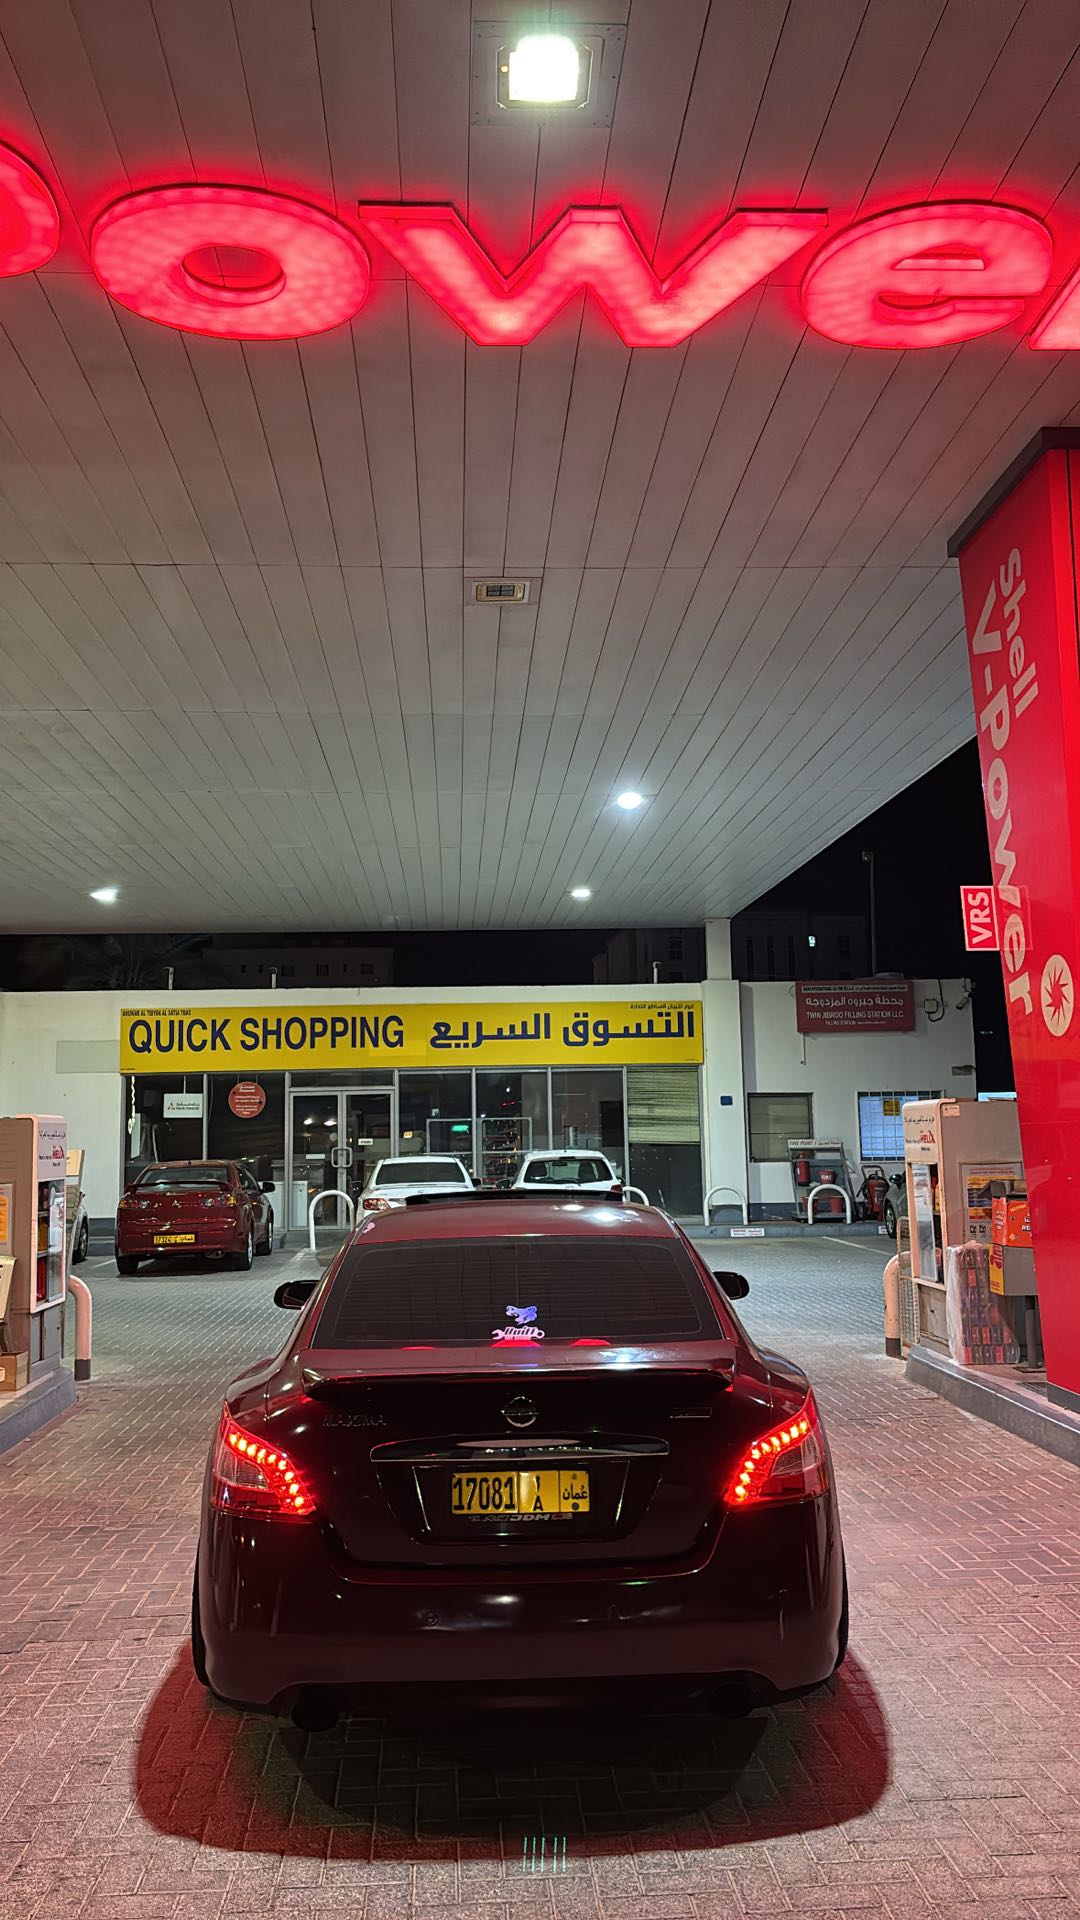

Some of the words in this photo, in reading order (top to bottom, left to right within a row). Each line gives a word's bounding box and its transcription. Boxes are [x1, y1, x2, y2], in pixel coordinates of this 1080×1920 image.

[1000, 548, 1039, 719] Shell
[972, 578, 1033, 1017] V-Power
[967, 891, 992, 945] VRS
[430, 1013, 551, 1049] السريع
[562, 1011, 694, 1047] التسوق
[844, 1010, 867, 1019] FILLING
[867, 1010, 891, 1018] STATION
[129, 1018, 231, 1054] QUICK
[240, 1015, 404, 1051] SHOPPING
[453, 1477, 515, 1510] 17081
[533, 1496, 544, 1511] A
